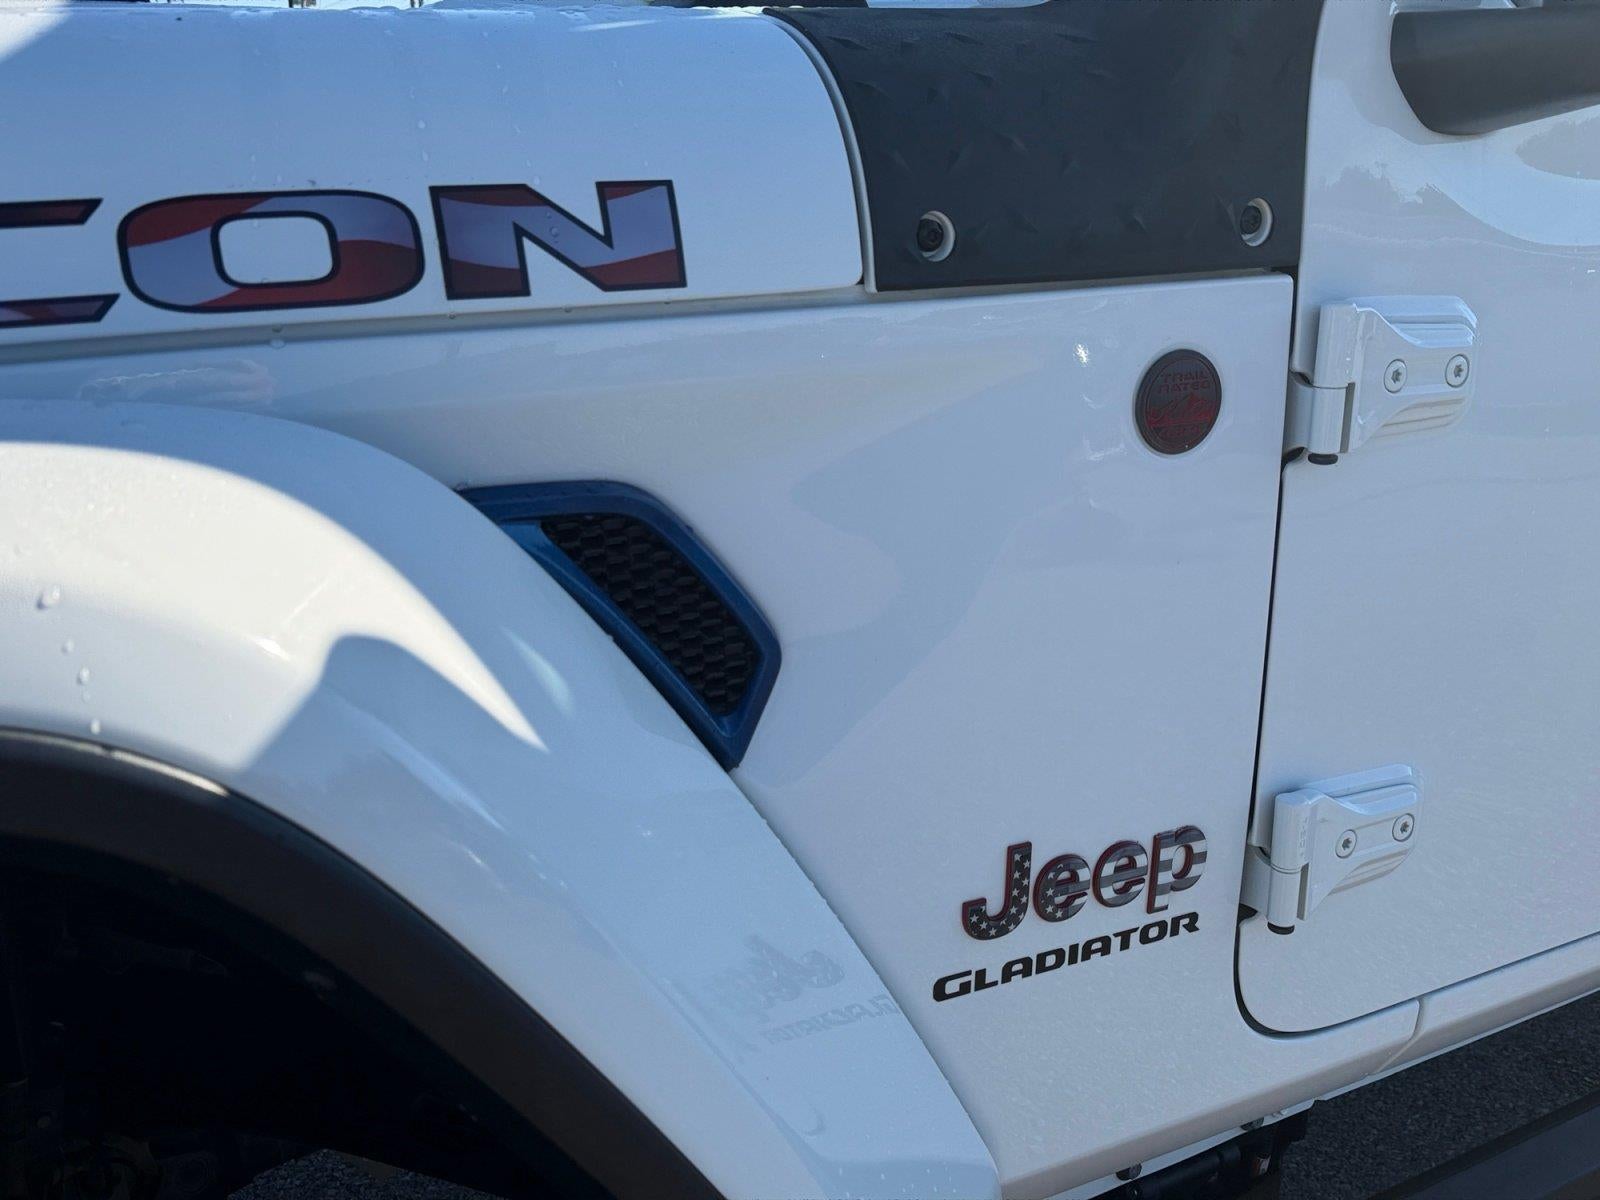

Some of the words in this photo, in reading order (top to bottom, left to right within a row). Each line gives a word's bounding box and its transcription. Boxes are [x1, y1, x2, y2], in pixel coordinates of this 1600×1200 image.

[1159, 370, 1209, 383] TRAIL
[961, 824, 1208, 940] Jeep
[932, 911, 1200, 1002] GLADIATOR
